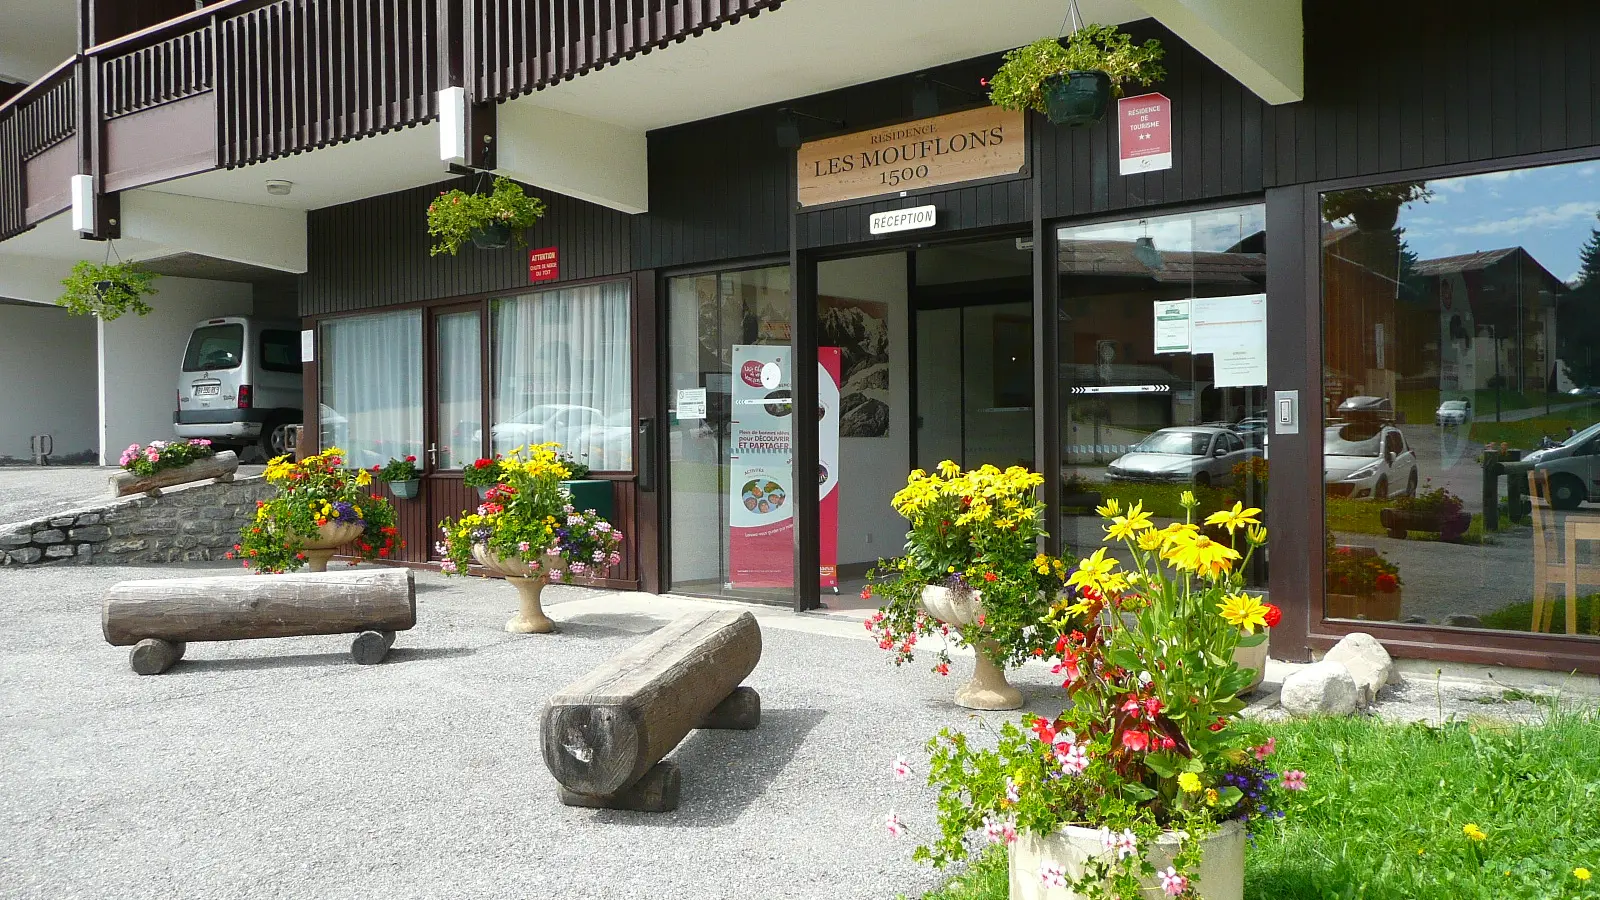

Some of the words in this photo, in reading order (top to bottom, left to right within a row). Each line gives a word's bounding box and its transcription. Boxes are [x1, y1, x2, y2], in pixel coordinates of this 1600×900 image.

[1127, 105, 1161, 116] RÉSIDENCE
[1140, 114, 1149, 122] DE
[1130, 120, 1160, 131] TOURISME
[814, 154, 854, 177] LES
[860, 126, 1004, 169] MOUFLONS
[879, 164, 929, 187] 1500
[873, 209, 933, 230] RÉCEPTION
[532, 252, 555, 262] ATTENTION
[754, 434, 790, 443] DÉCOUVRIR
[749, 442, 790, 450] PARTAGER
